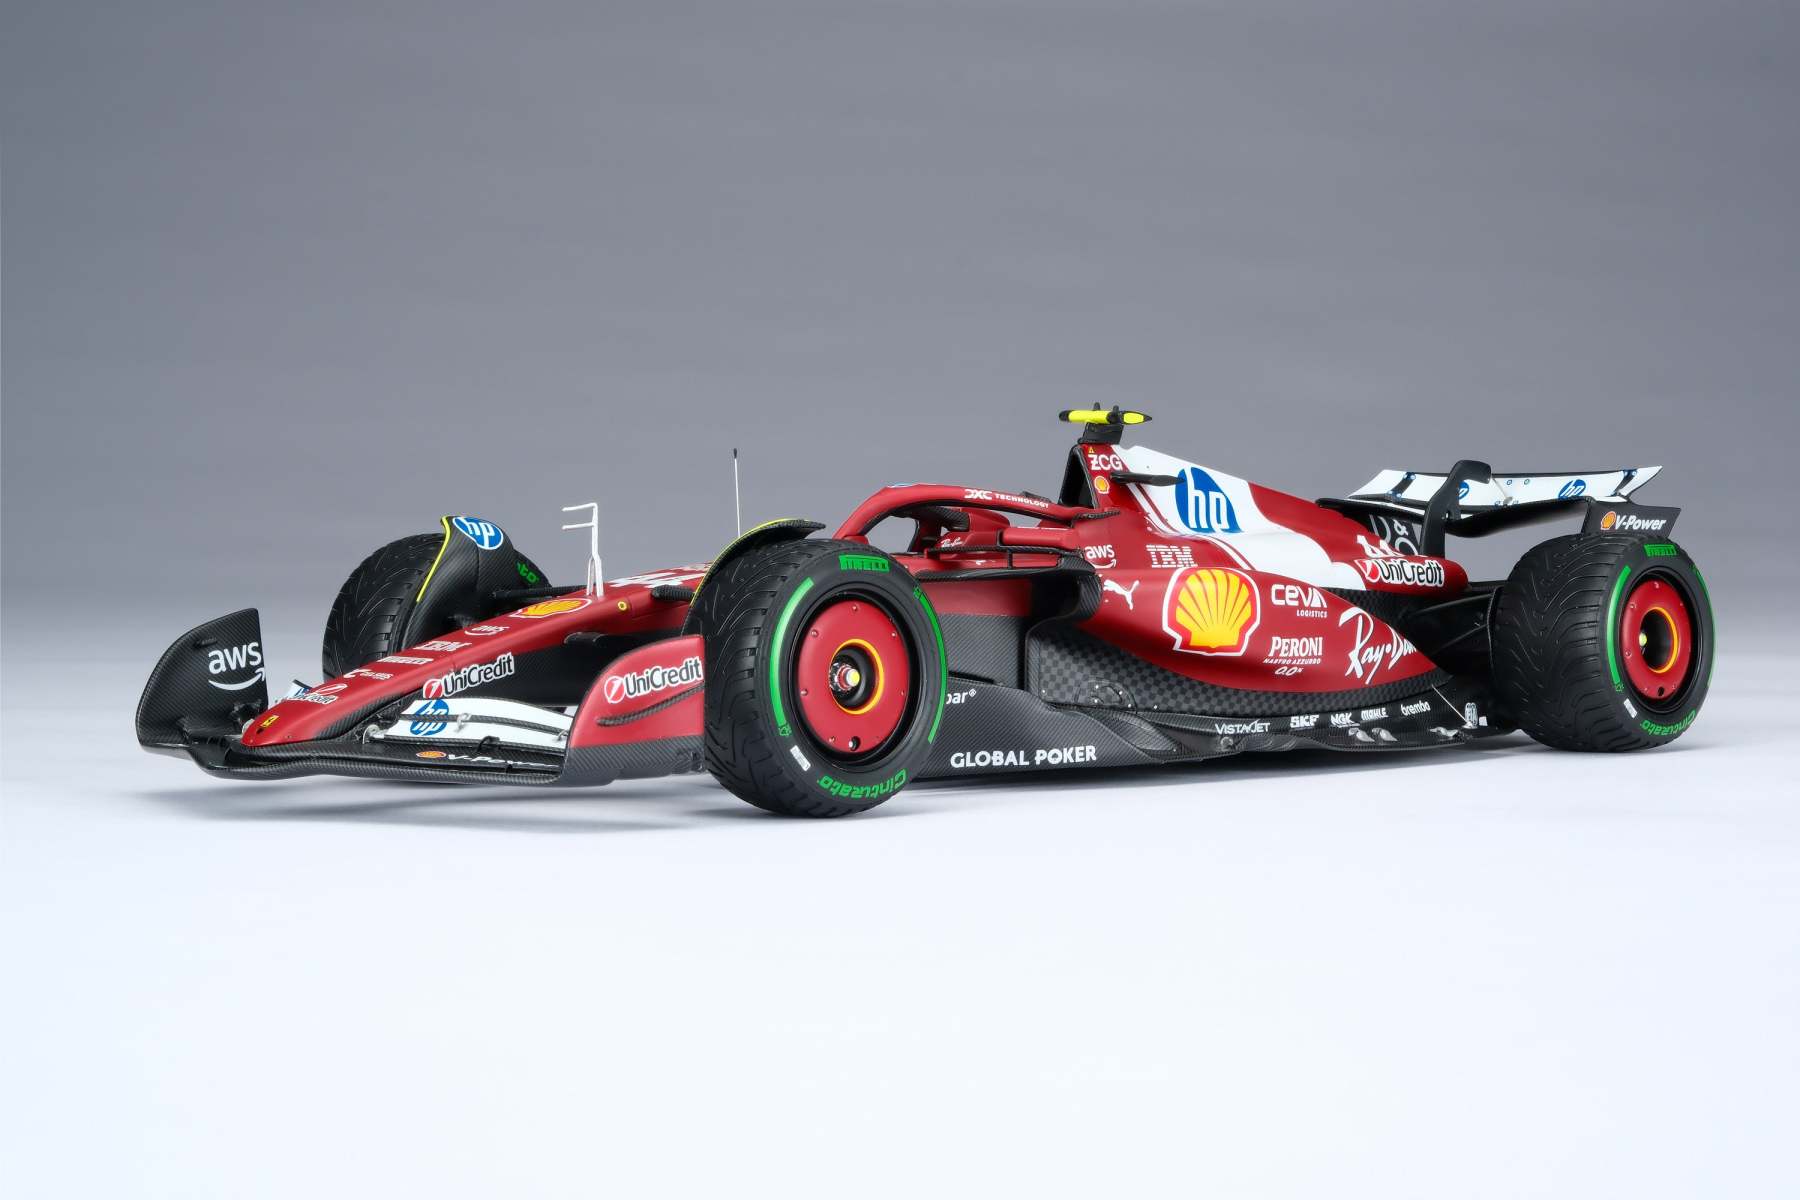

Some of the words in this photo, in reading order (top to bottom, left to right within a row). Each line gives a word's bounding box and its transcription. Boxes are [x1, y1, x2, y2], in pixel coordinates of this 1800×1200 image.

[995, 493, 1049, 509] TECHNOLOGY
[1183, 467, 1234, 533] hp
[460, 516, 498, 549] hp
[1615, 514, 1667, 530] V-Power
[1084, 544, 1115, 559] aws
[1146, 544, 1198, 568] IBM
[1376, 560, 1444, 587] UniCredit
[1296, 609, 1328, 618] LOGISTICS
[1268, 636, 1324, 657] PERONI
[208, 641, 263, 675] aws
[442, 652, 514, 698] UniCredit
[623, 656, 704, 699] UniCredit
[1330, 712, 1354, 725] NGK
[1401, 700, 1431, 716] brembo
[1290, 714, 1320, 728] SKF
[950, 751, 1030, 768] GLOBAL
[1034, 745, 1097, 765] POKER
